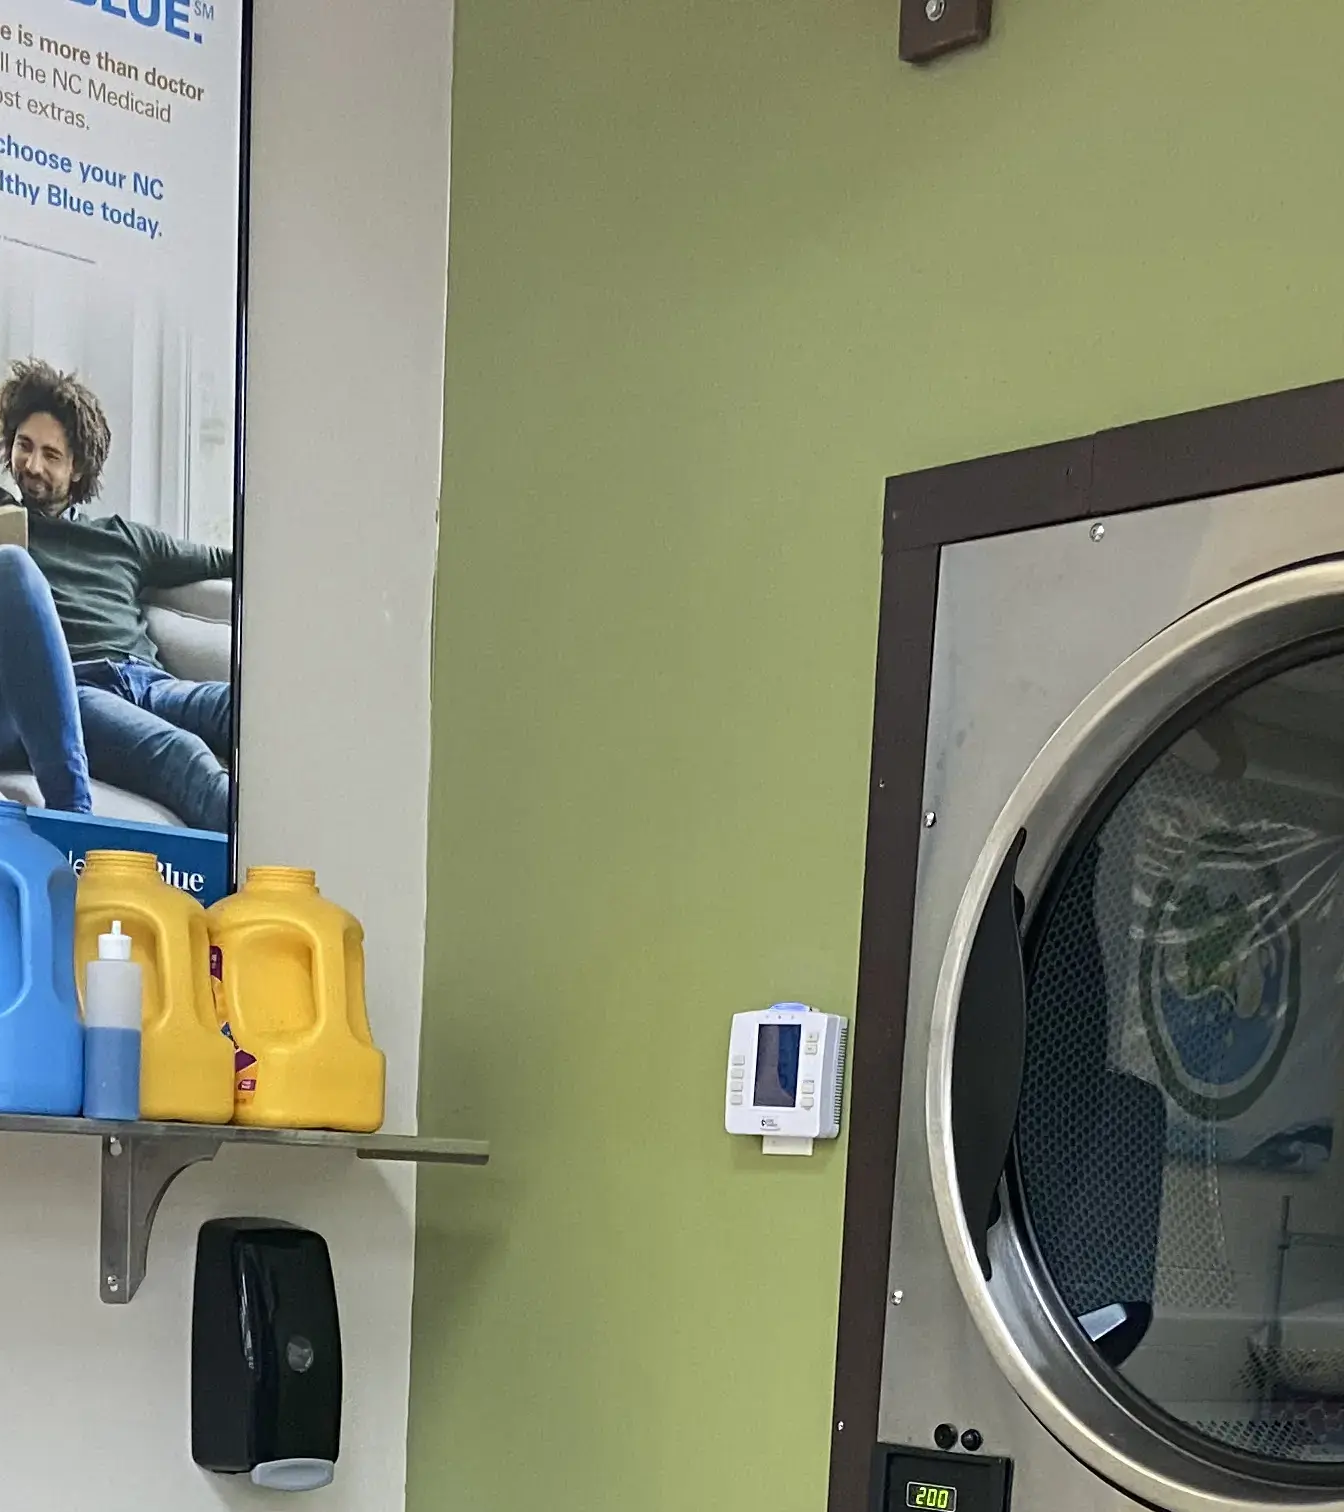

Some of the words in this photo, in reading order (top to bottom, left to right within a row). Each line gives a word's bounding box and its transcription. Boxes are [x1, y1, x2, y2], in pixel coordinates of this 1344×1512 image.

[17, 24, 34, 48] is
[39, 35, 91, 66] more
[96, 50, 139, 82] than
[144, 66, 205, 102] doctor
[15, 57, 47, 85] the
[52, 67, 82, 95] NC
[87, 78, 172, 125] Medicaid
[26, 98, 91, 131] extras.
[78, 161, 127, 190] your
[132, 171, 164, 201] NC
[47, 183, 94, 217] Blue
[100, 201, 164, 240] today.
[915, 1487, 948, 1509] 200
